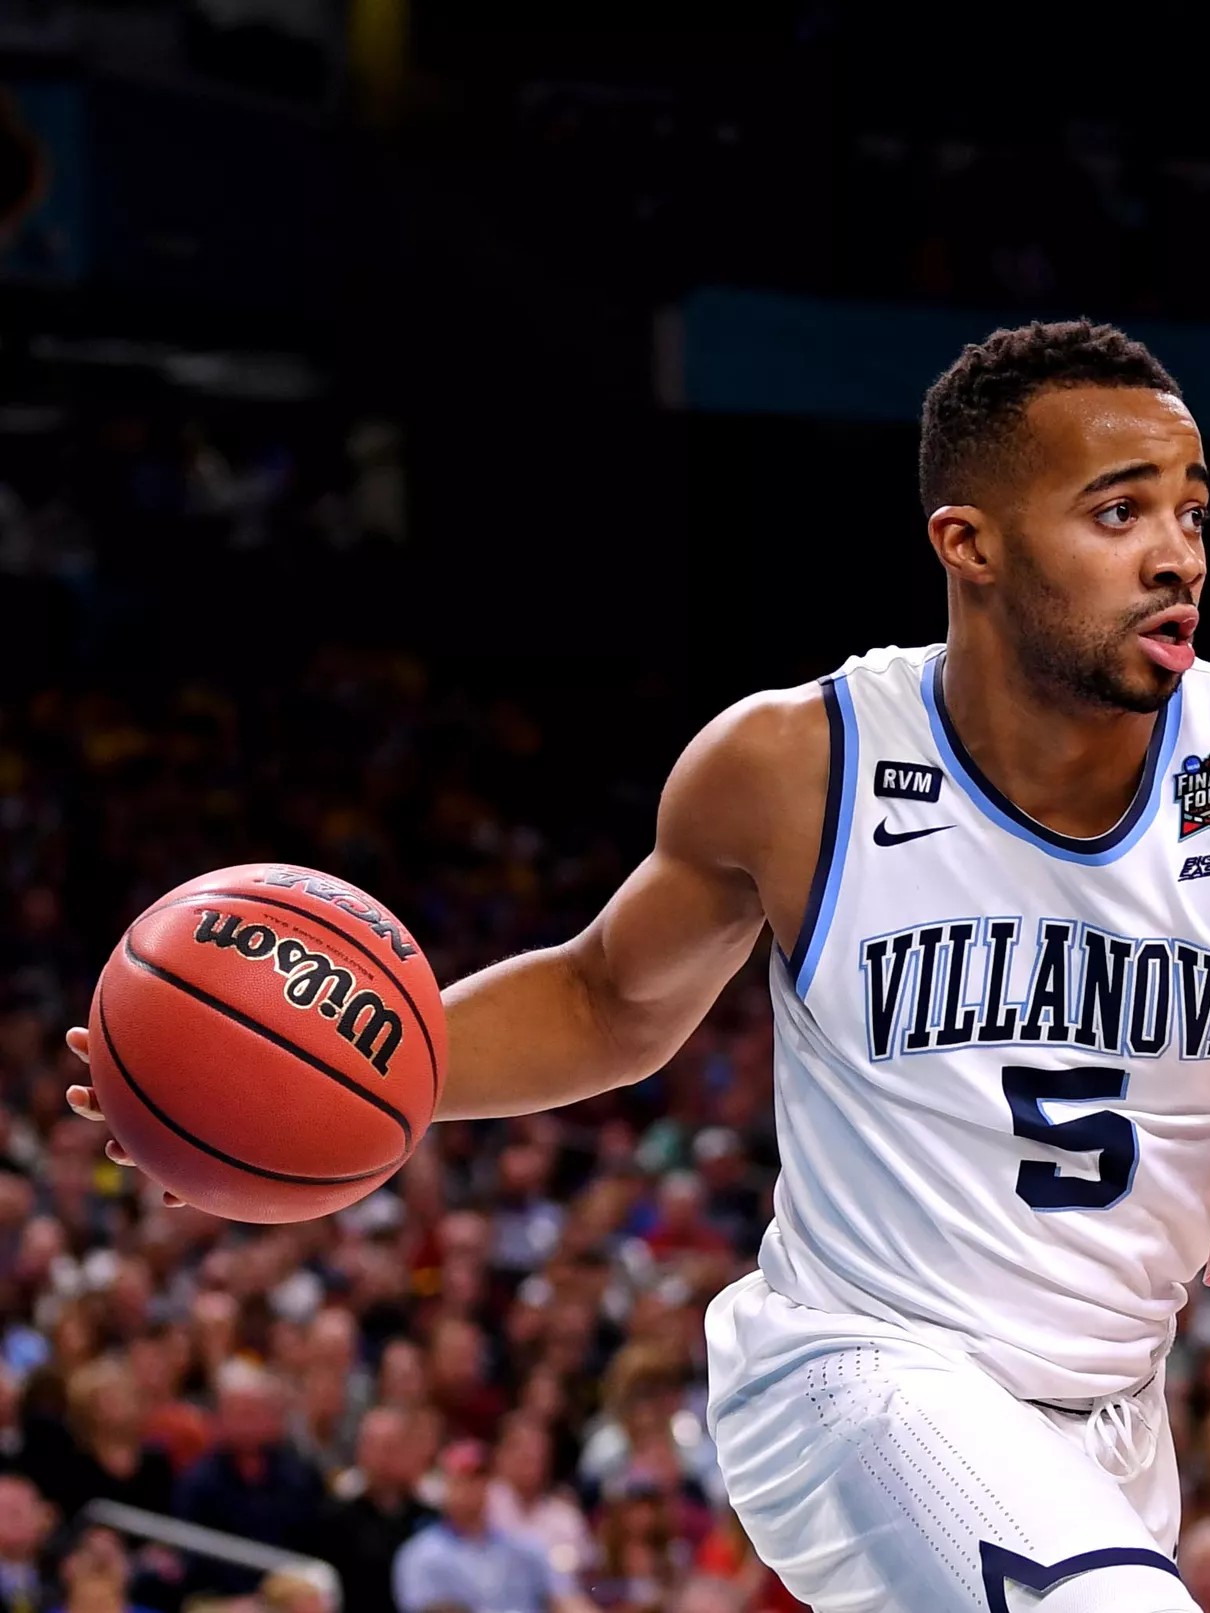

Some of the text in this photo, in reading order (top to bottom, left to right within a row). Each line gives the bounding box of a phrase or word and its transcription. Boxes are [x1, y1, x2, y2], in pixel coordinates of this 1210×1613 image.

[882, 767, 933, 795] RVM
[265, 871, 417, 961] NCAA
[194, 909, 403, 1077] Wilson
[1001, 1066, 1141, 1213] 5
